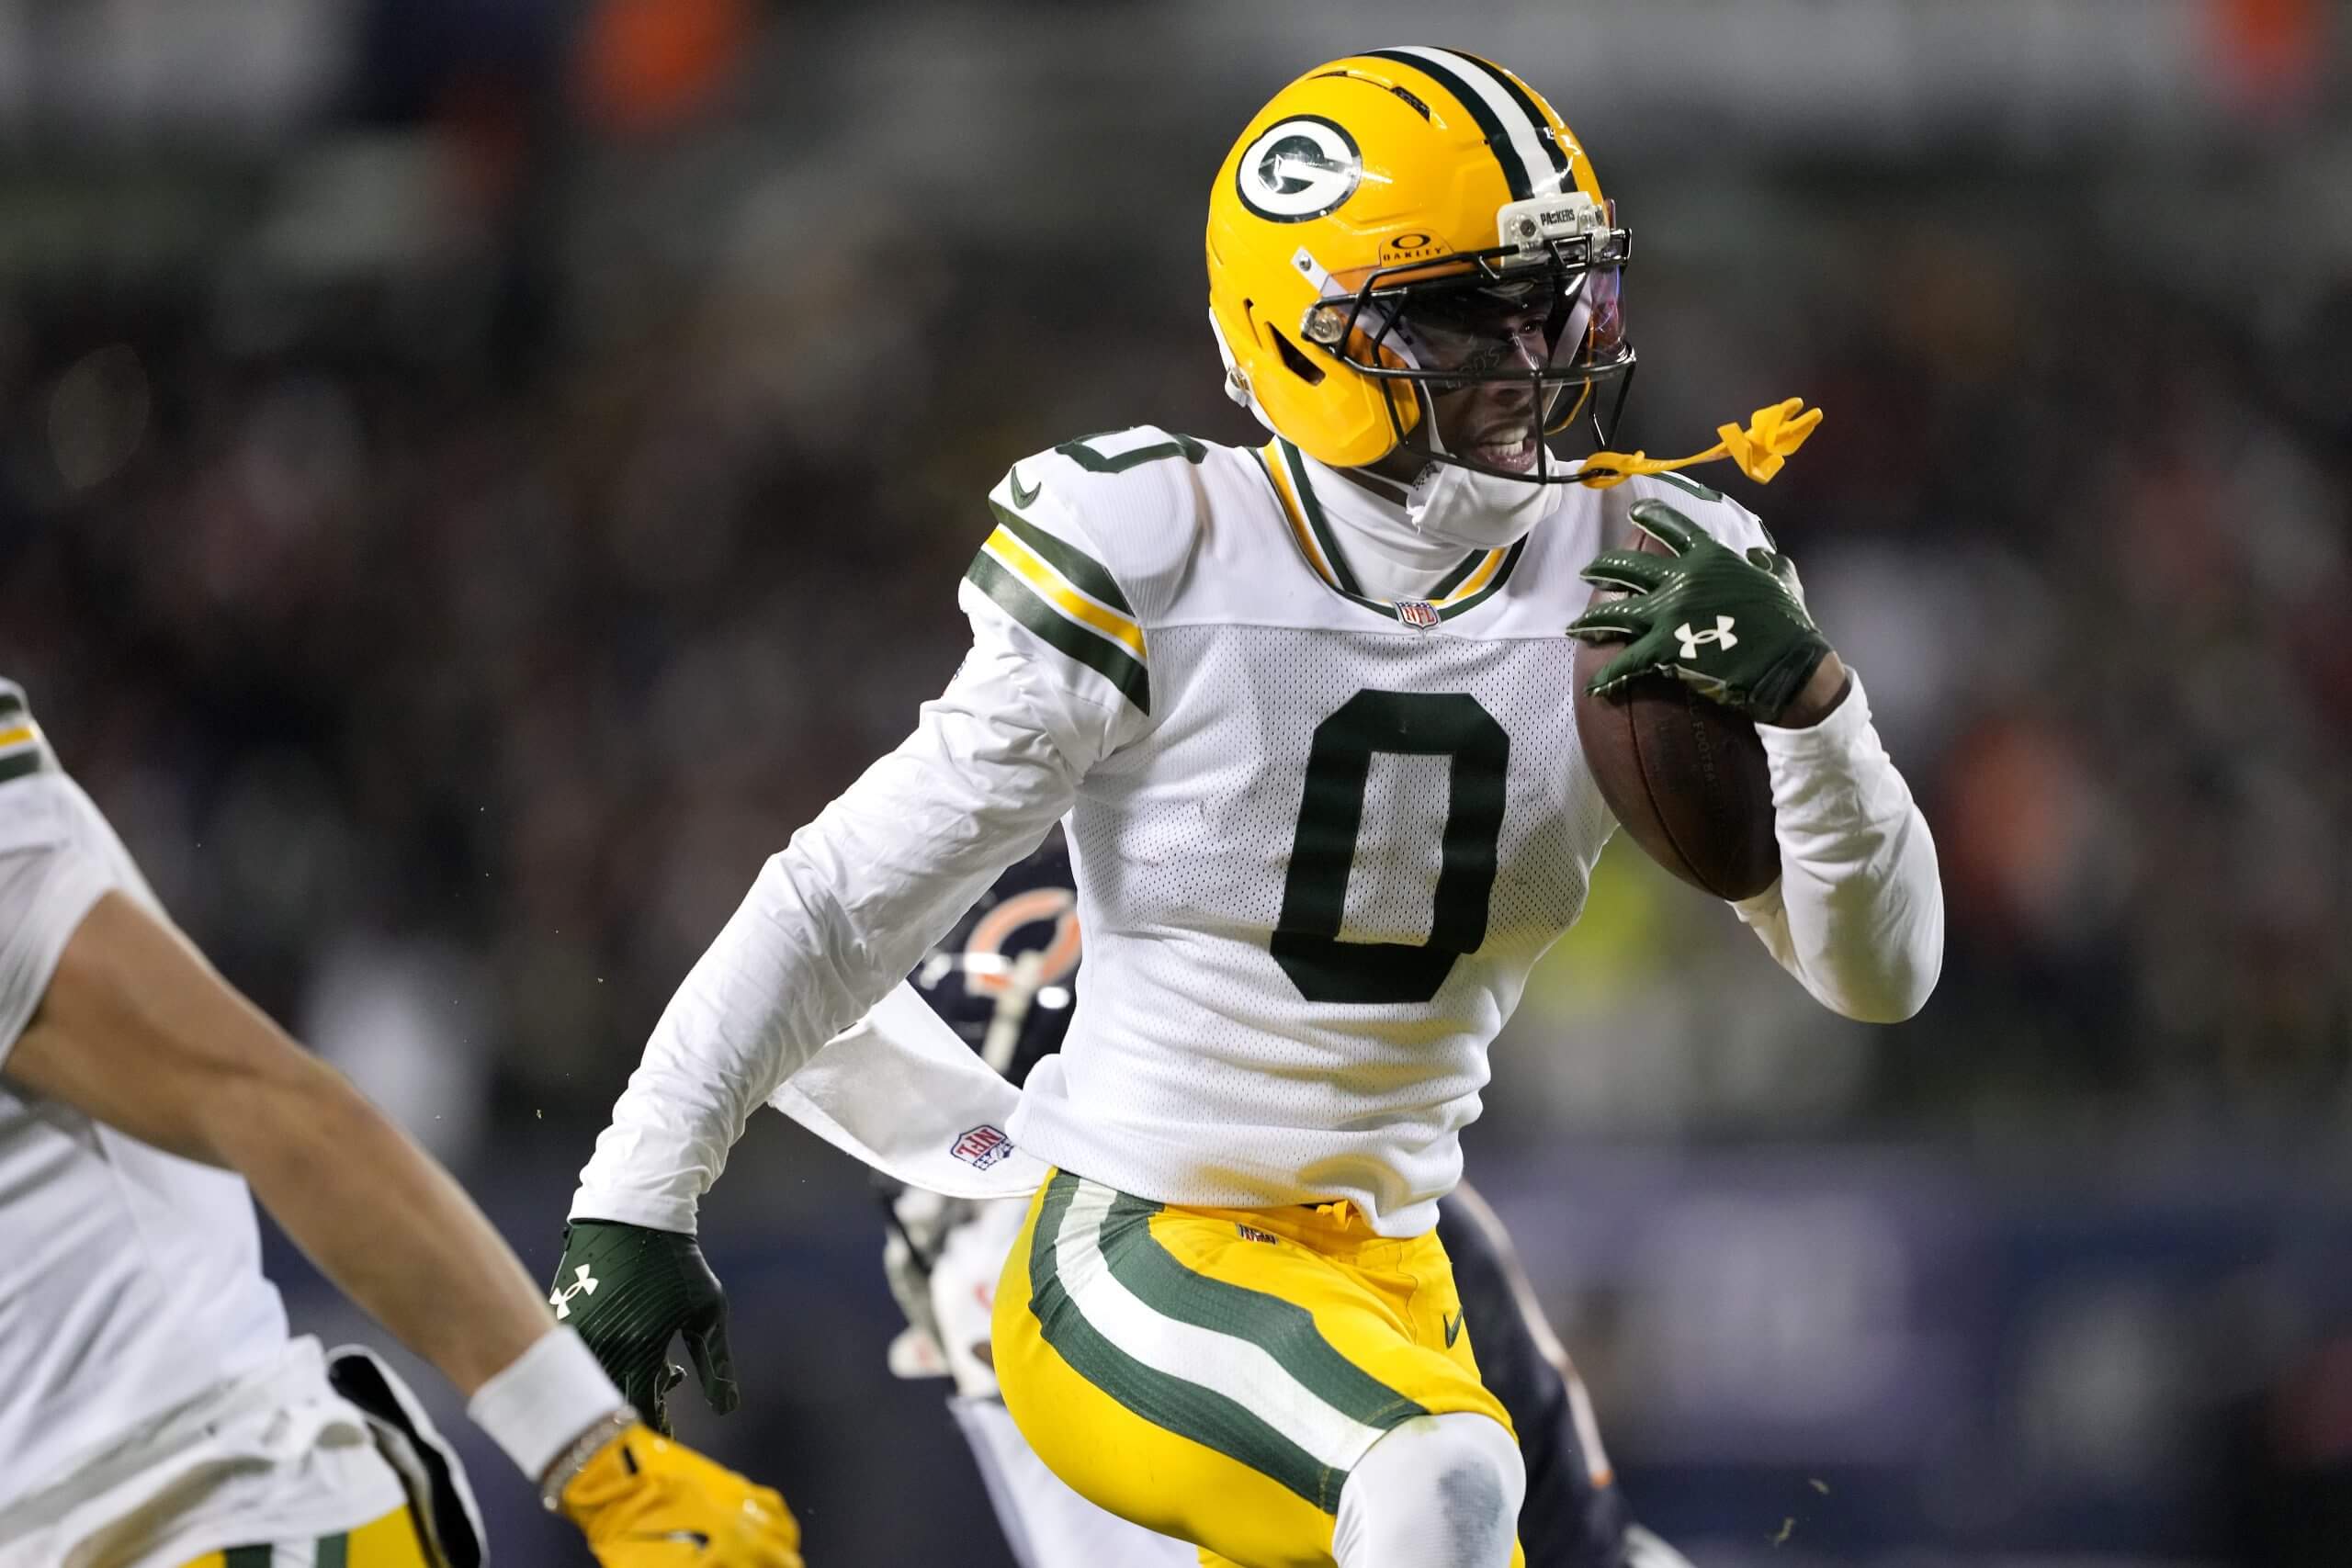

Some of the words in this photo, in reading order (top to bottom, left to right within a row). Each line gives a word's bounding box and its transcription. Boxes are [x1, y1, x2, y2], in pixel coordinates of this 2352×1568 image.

[1237, 116, 1362, 222] G
[1540, 209, 1575, 226] PACKERS
[1383, 247, 1442, 261] OAKLEY
[1402, 606, 1435, 626] NFL
[1270, 688, 1510, 1004] 0
[956, 1128, 1002, 1158] NFL
